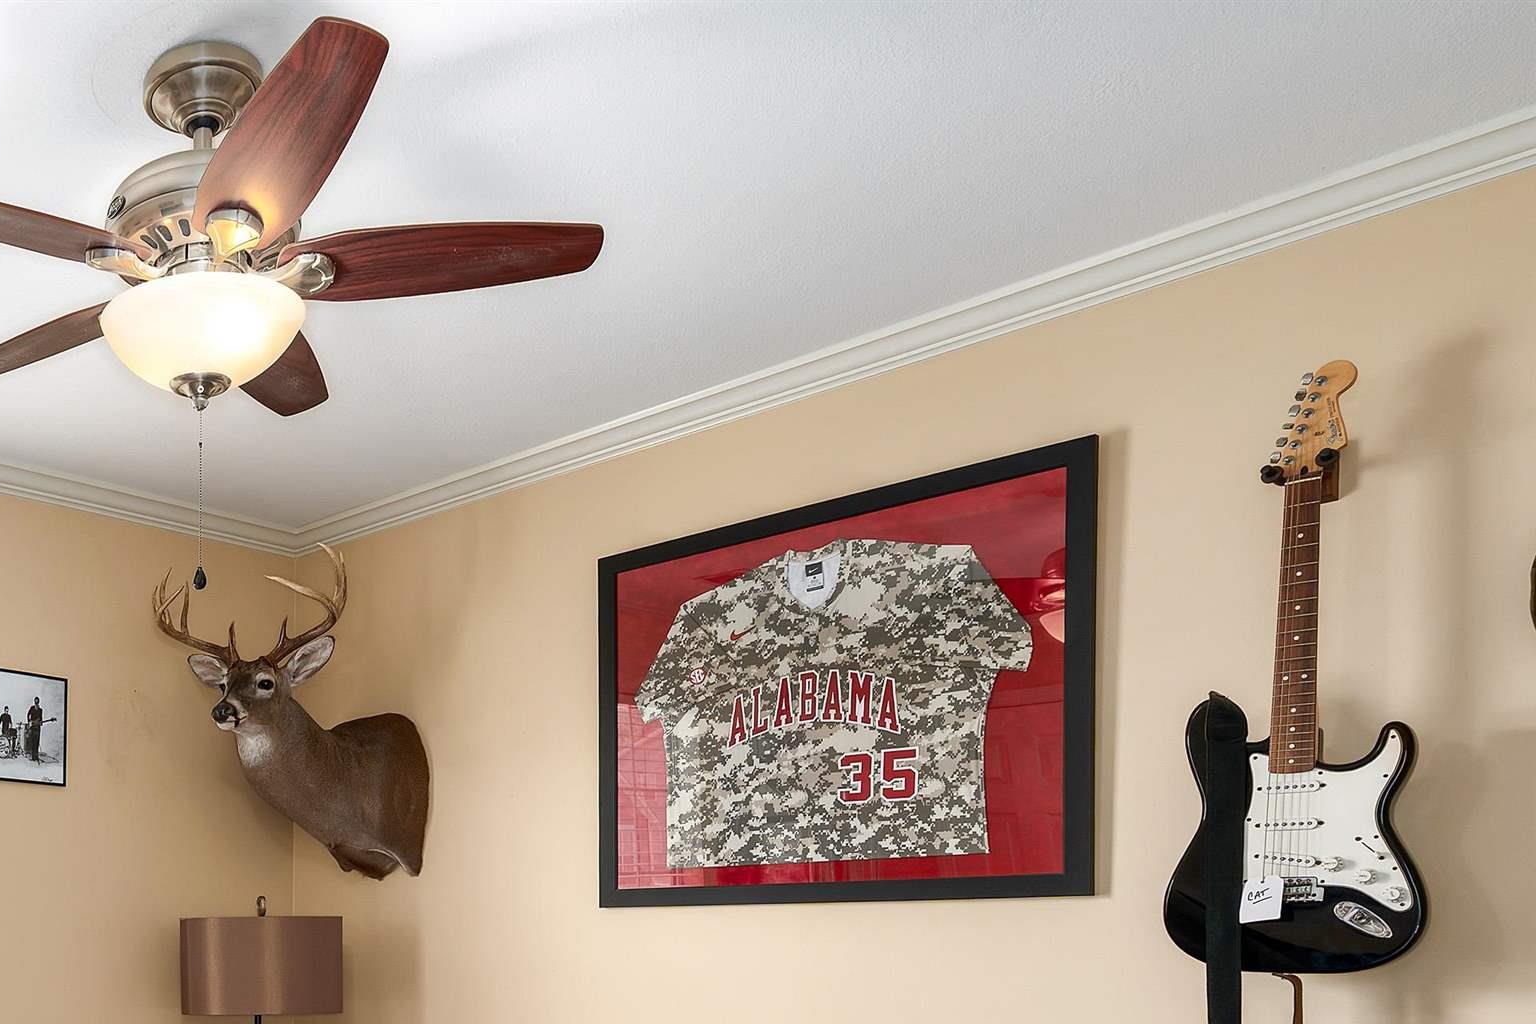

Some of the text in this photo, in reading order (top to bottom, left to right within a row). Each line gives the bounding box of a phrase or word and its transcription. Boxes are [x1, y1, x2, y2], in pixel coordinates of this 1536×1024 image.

[727, 669, 902, 750] ALABAMA
[837, 747, 920, 805] 35
[1247, 887, 1270, 901] CAT
